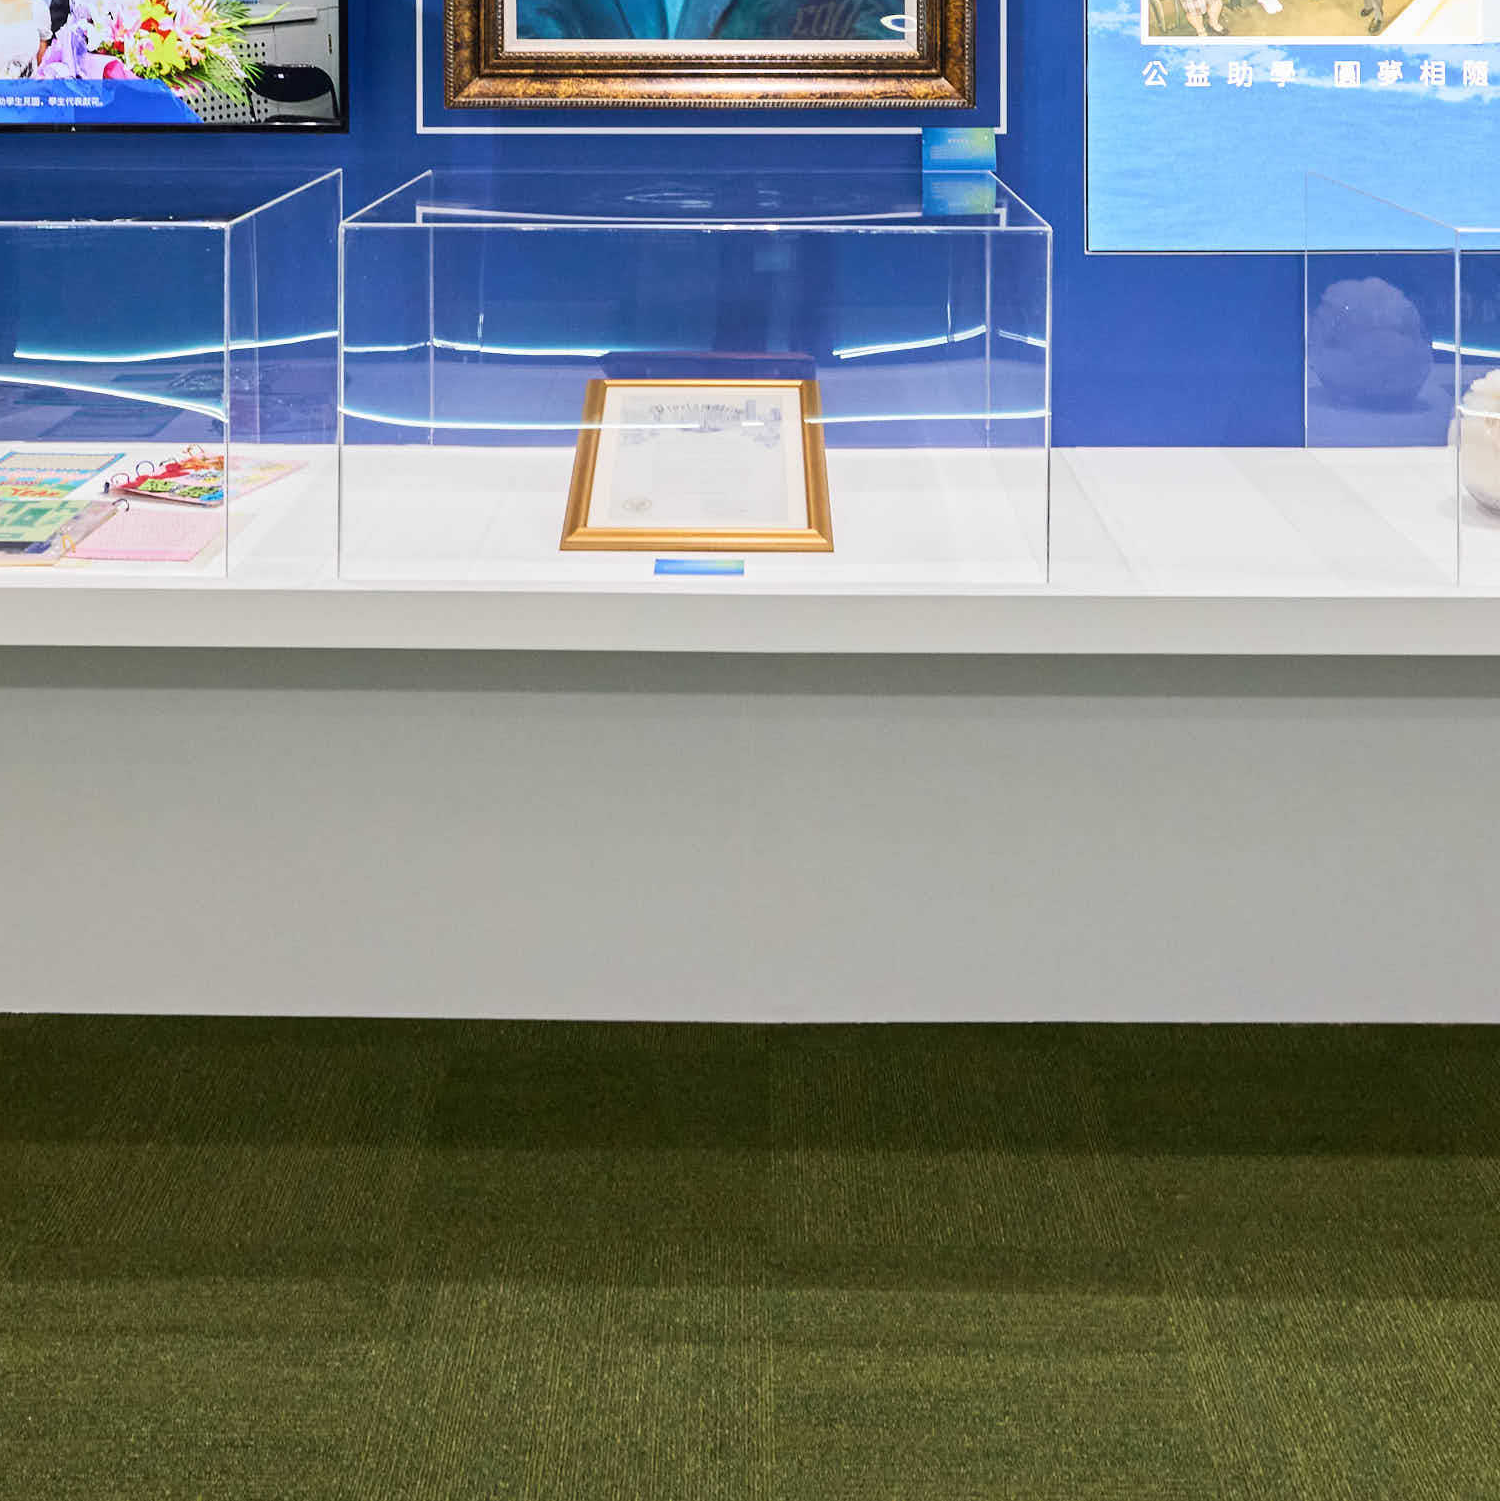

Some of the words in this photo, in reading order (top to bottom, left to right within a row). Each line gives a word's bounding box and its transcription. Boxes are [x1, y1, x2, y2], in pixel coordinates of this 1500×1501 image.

[1142, 60, 1297, 88] 公益助學
[1334, 60, 1491, 88] 圓夢相隨
